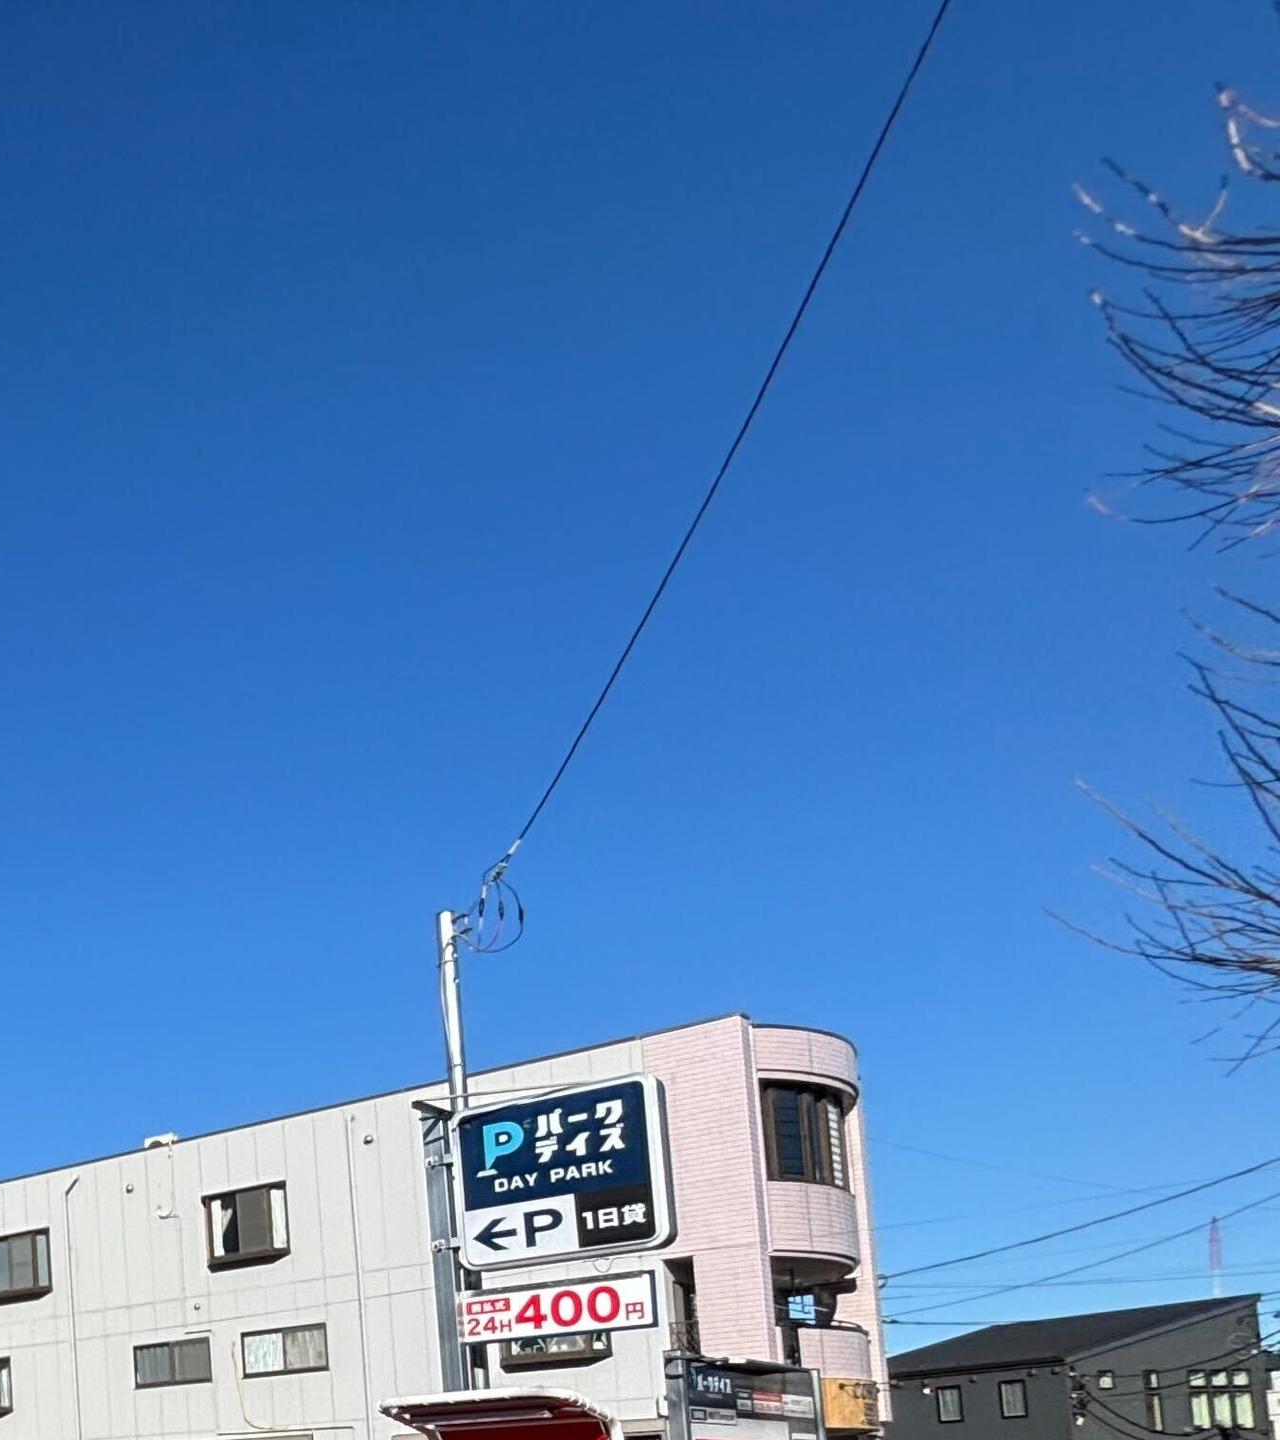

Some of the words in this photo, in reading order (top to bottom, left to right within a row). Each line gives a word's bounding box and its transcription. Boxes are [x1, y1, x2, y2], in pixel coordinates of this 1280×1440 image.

[535, 1099, 623, 1138] パーク
[534, 1123, 626, 1163] デイズ
[494, 1172, 538, 1192] DAY
[550, 1159, 613, 1183] PARK
[523, 1208, 563, 1248] P
[581, 1202, 647, 1230] 1日貸
[467, 1316, 512, 1337] 24H
